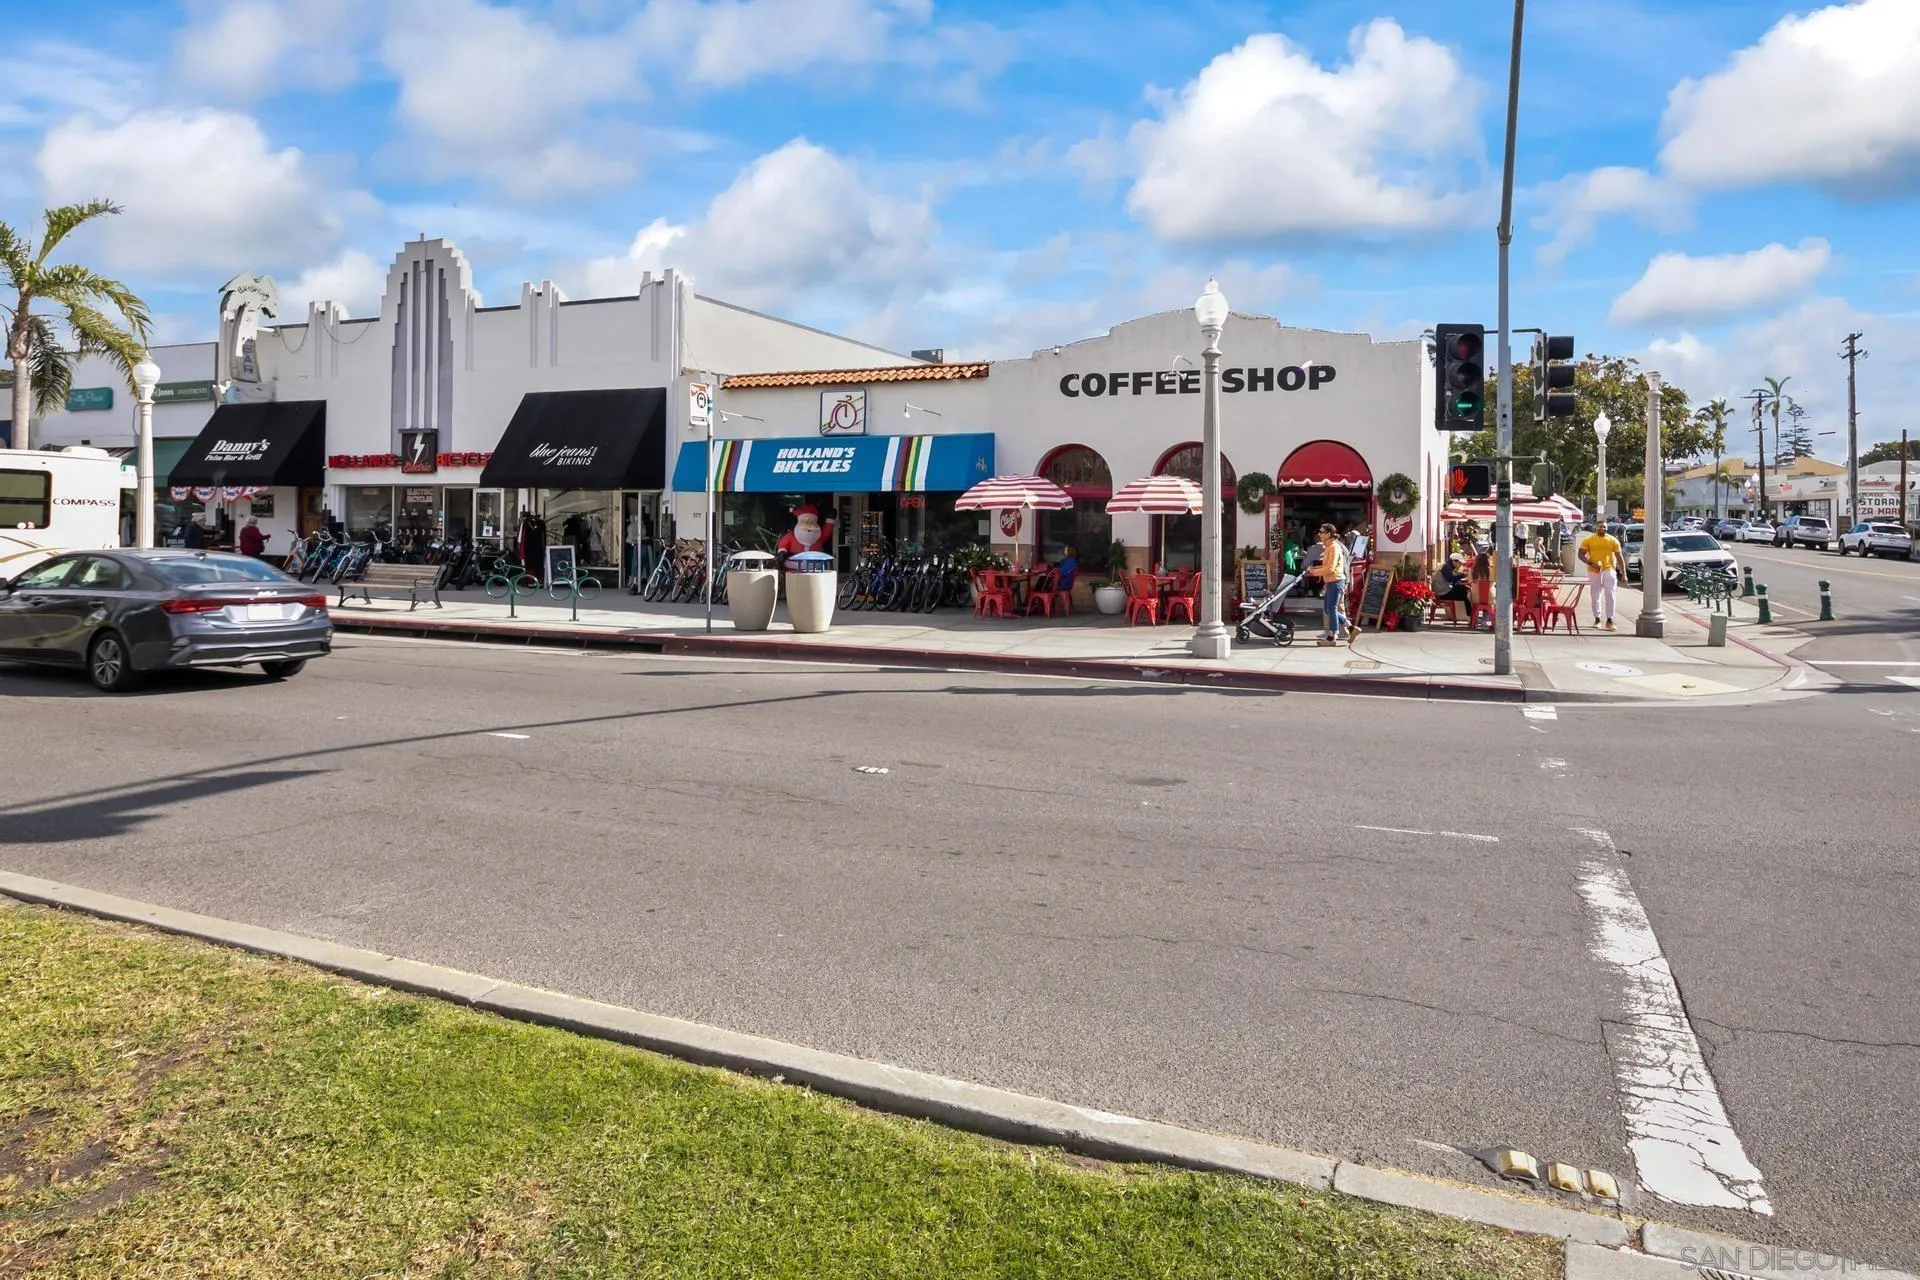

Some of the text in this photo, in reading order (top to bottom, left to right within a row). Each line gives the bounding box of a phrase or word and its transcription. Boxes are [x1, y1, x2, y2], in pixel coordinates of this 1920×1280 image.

[1060, 366, 1336, 397] COFFEE SHOP
[211, 439, 271, 453] Danny's
[777, 448, 856, 459] HOLLAND'S
[556, 457, 593, 466] BIKINIS
[772, 460, 853, 473] BICYCLES
[53, 498, 116, 507] COMPASS
[901, 497, 924, 508] OPEN
